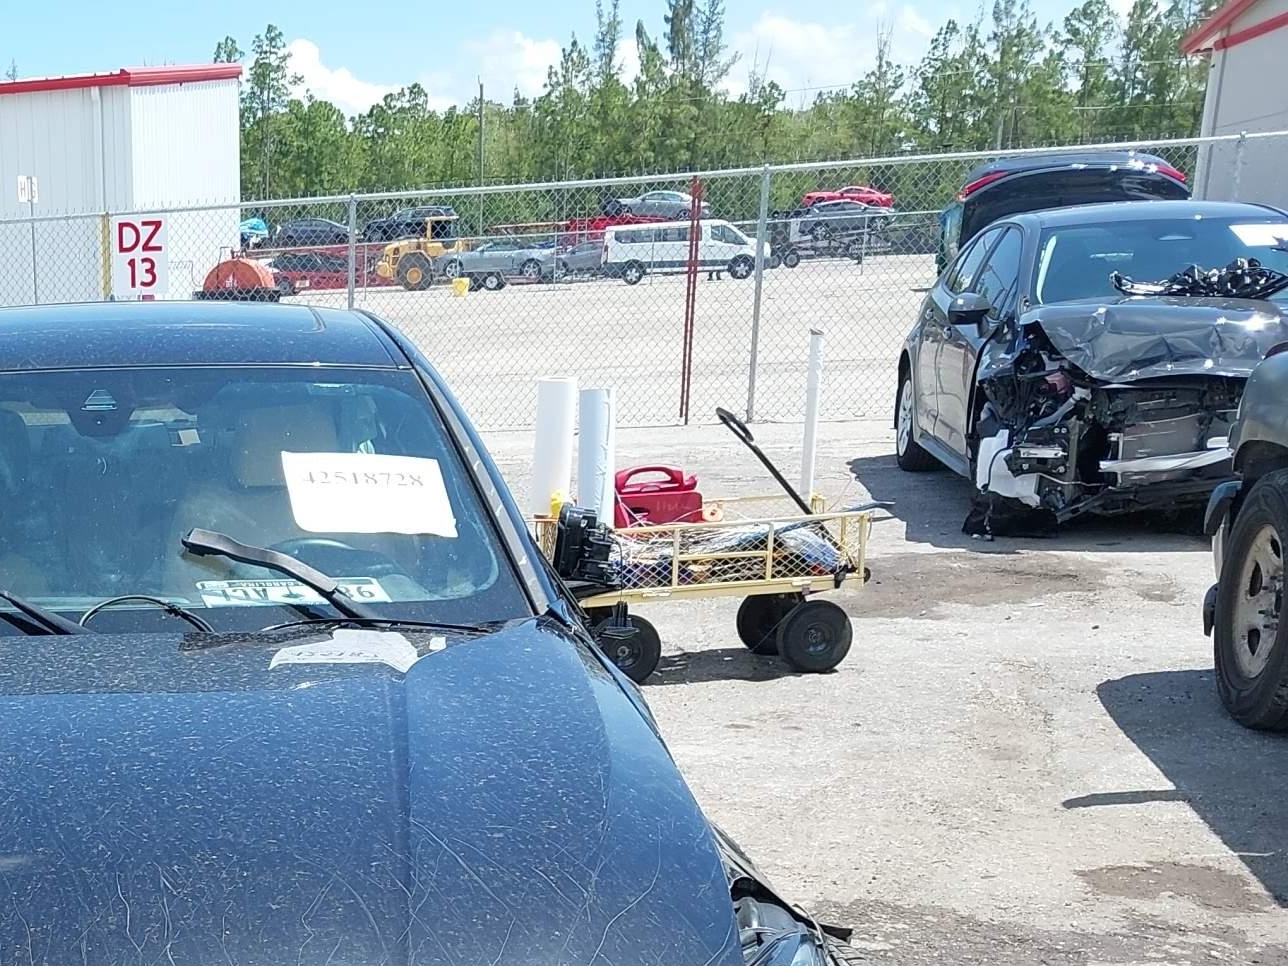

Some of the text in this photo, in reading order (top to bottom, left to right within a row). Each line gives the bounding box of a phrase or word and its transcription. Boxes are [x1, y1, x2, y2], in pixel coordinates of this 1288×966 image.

[117, 219, 163, 254] DZ
[127, 257, 157, 289] 13
[302, 469, 425, 488] 42518728
